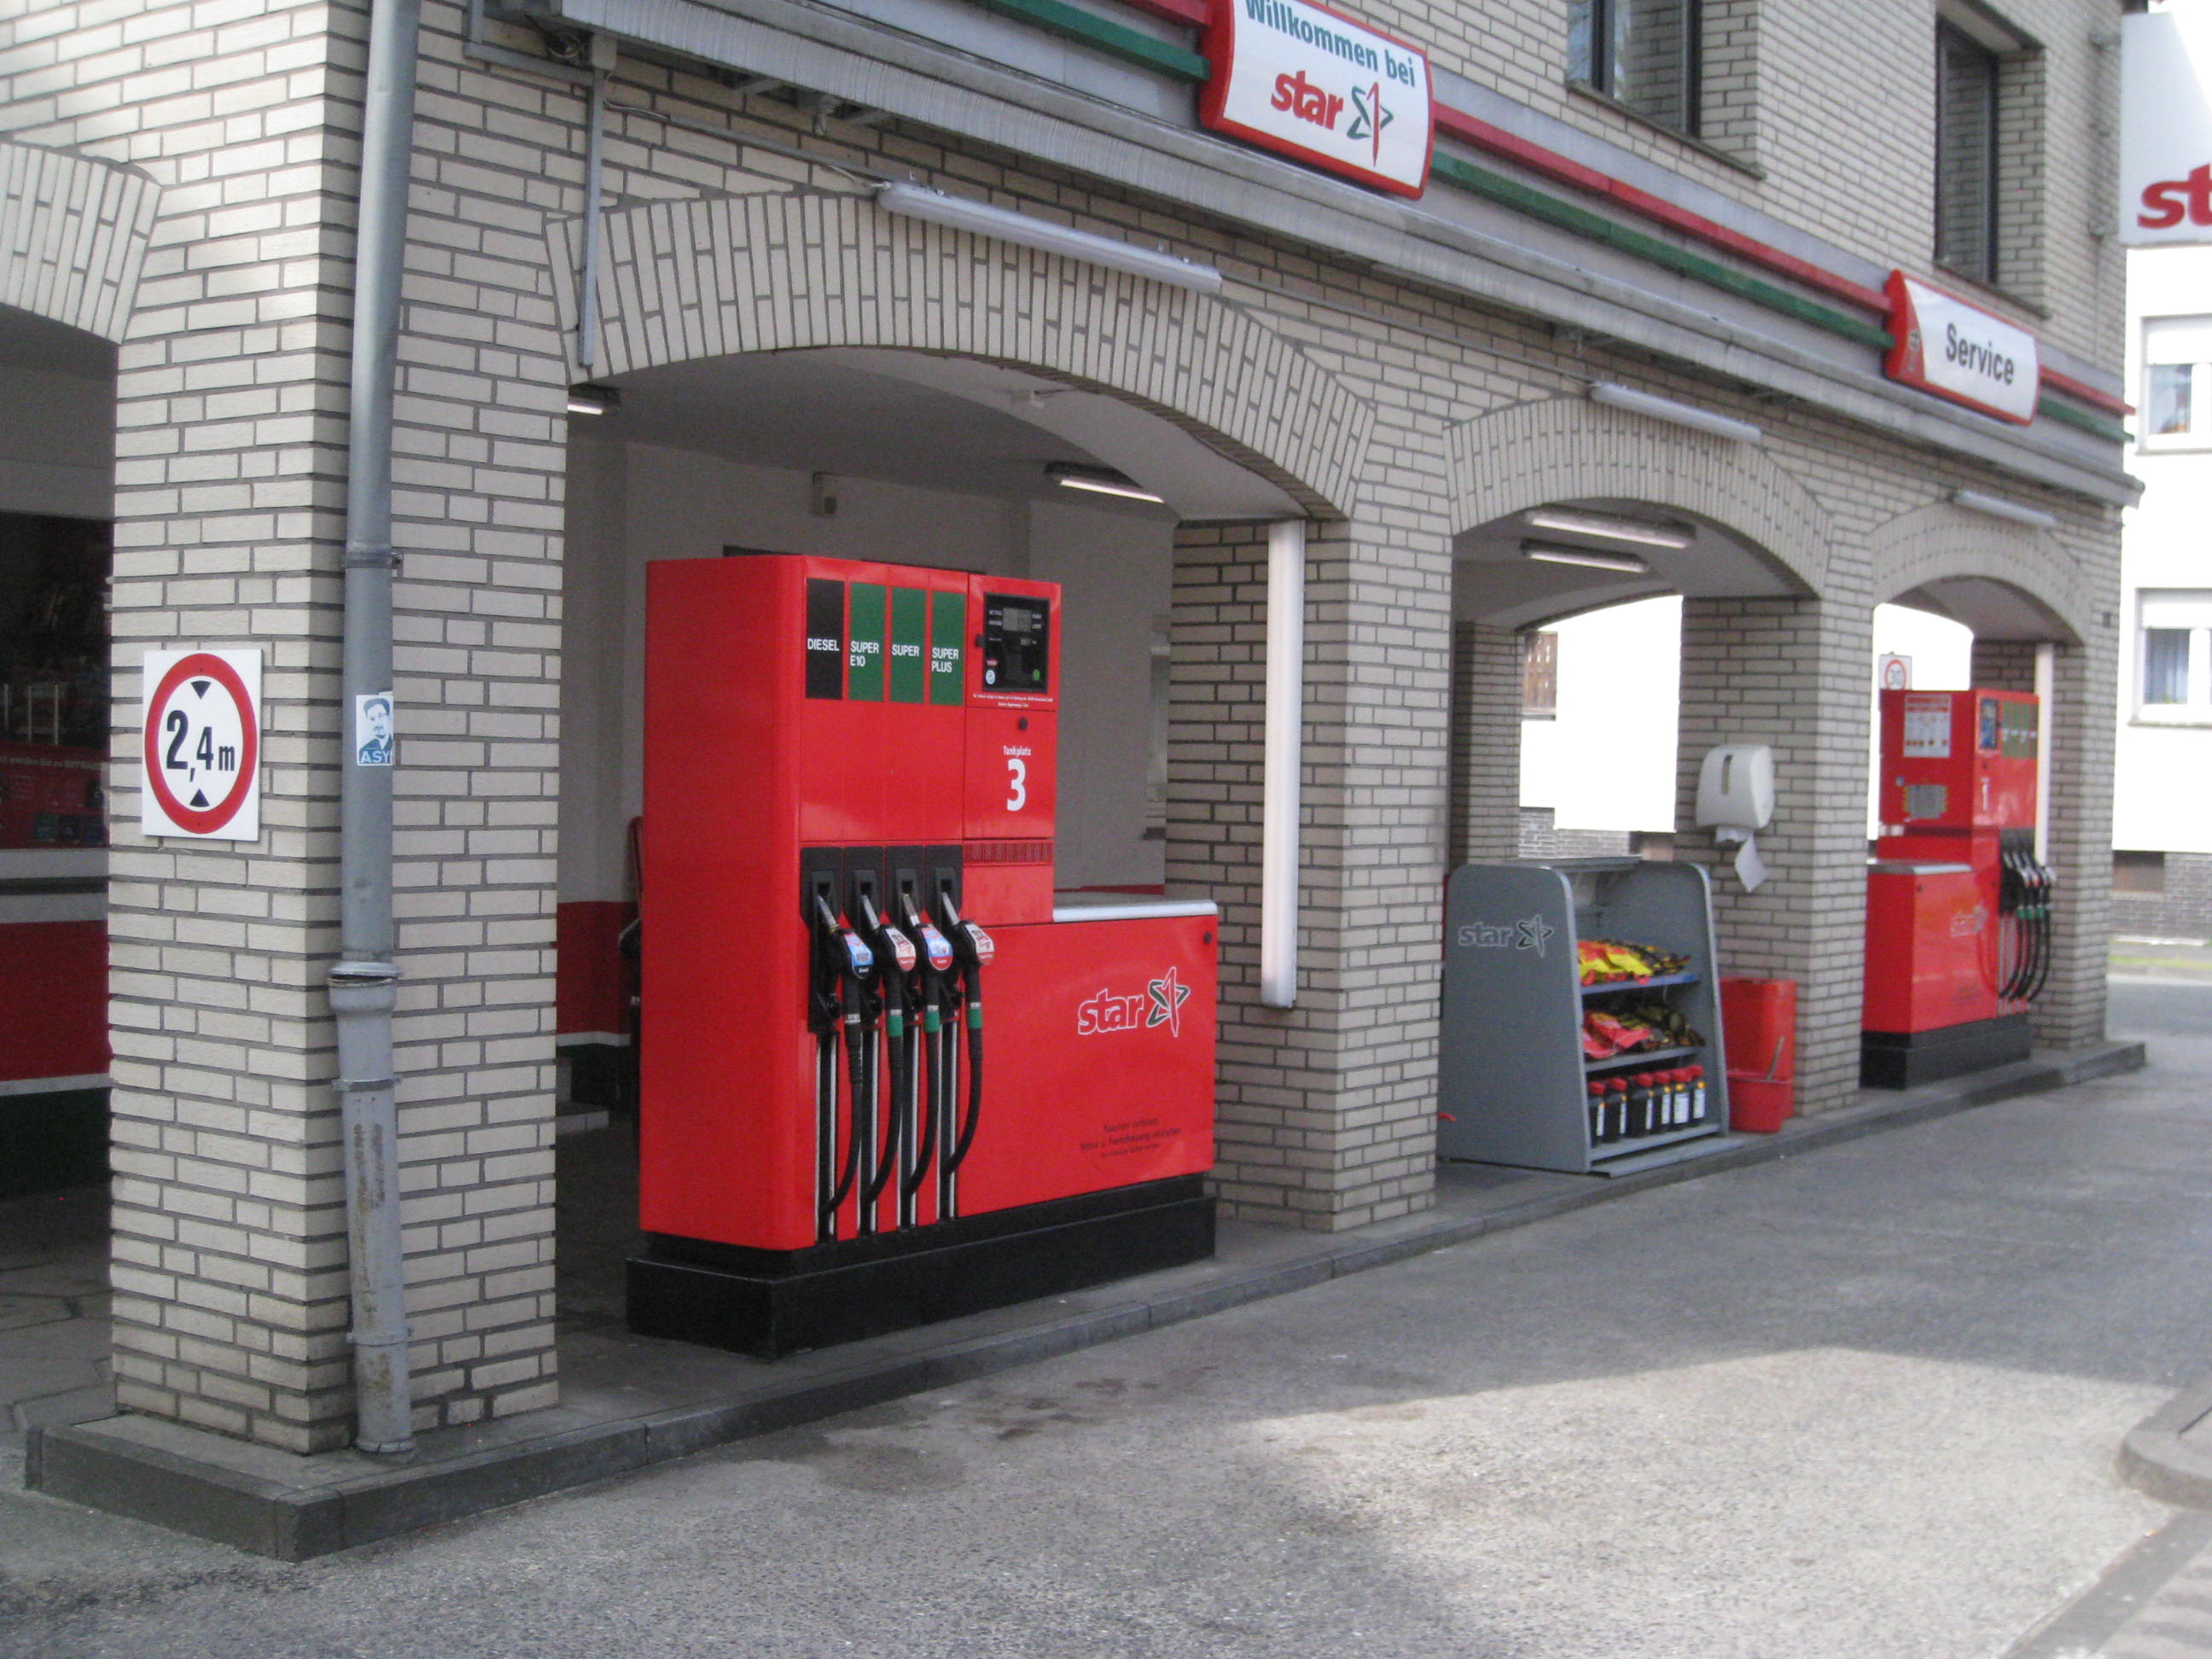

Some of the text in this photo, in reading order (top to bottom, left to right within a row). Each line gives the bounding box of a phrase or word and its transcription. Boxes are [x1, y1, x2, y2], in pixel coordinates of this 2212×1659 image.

[1246, 0, 1416, 88] Willkommen bei
[1271, 69, 1345, 131] star
[2137, 163, 2212, 230] st
[1946, 322, 2014, 386] Service
[807, 638, 840, 651] DIESEL
[850, 641, 879, 655] SUPER
[891, 644, 920, 657] SUPER
[932, 647, 959, 660] SUPER
[850, 655, 866, 667] E10
[931, 661, 953, 673] PLUS
[166, 709, 236, 783] 2,4 m
[1003, 745, 1032, 758] Tankplatz
[1006, 758, 1027, 812] 3
[1458, 922, 1514, 948] star
[1077, 987, 1145, 1036] star
